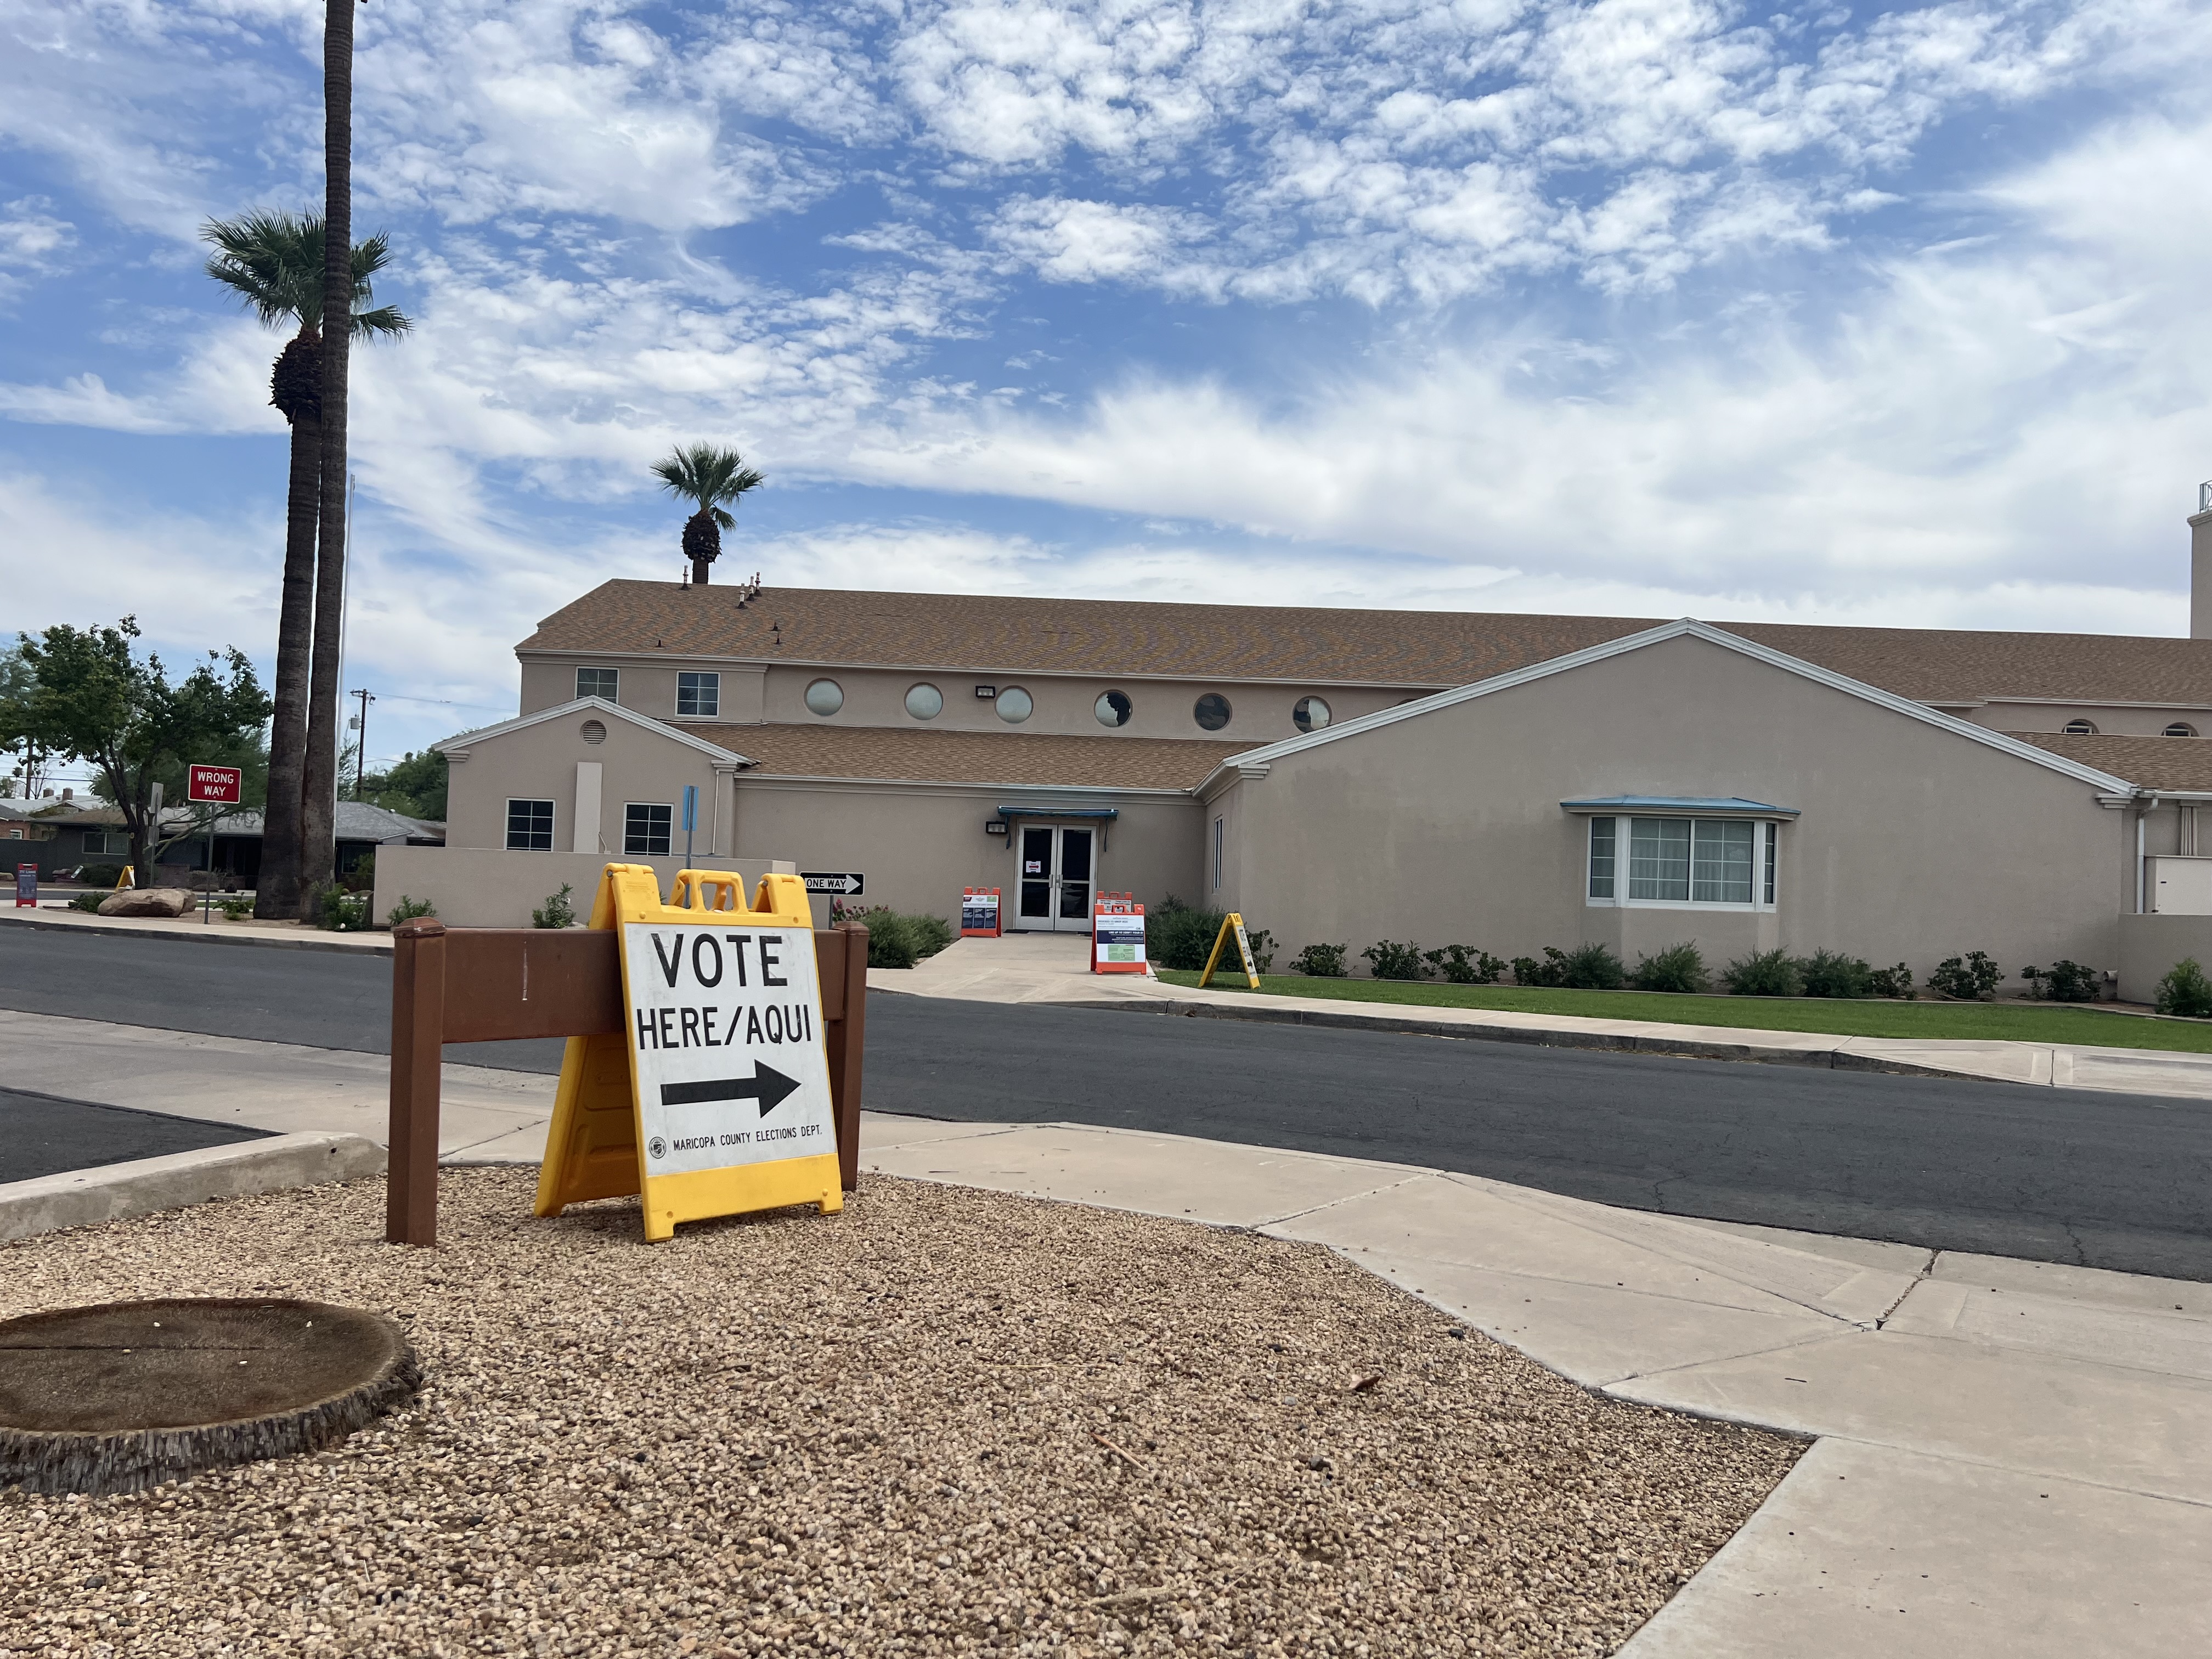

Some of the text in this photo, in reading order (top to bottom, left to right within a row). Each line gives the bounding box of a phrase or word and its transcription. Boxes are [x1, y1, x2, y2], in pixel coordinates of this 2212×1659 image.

[198, 771, 234, 784] WRONG
[204, 785, 226, 797] WAY
[806, 879, 847, 888] ONE WAY
[651, 933, 787, 988] VOTE
[636, 1005, 811, 1049] HERE/AQUI
[673, 1136, 715, 1151] MARICOPA
[720, 1132, 751, 1146] COUNTY
[756, 1127, 797, 1142] ELECTIONS
[801, 1125, 823, 1137] DEPT.
